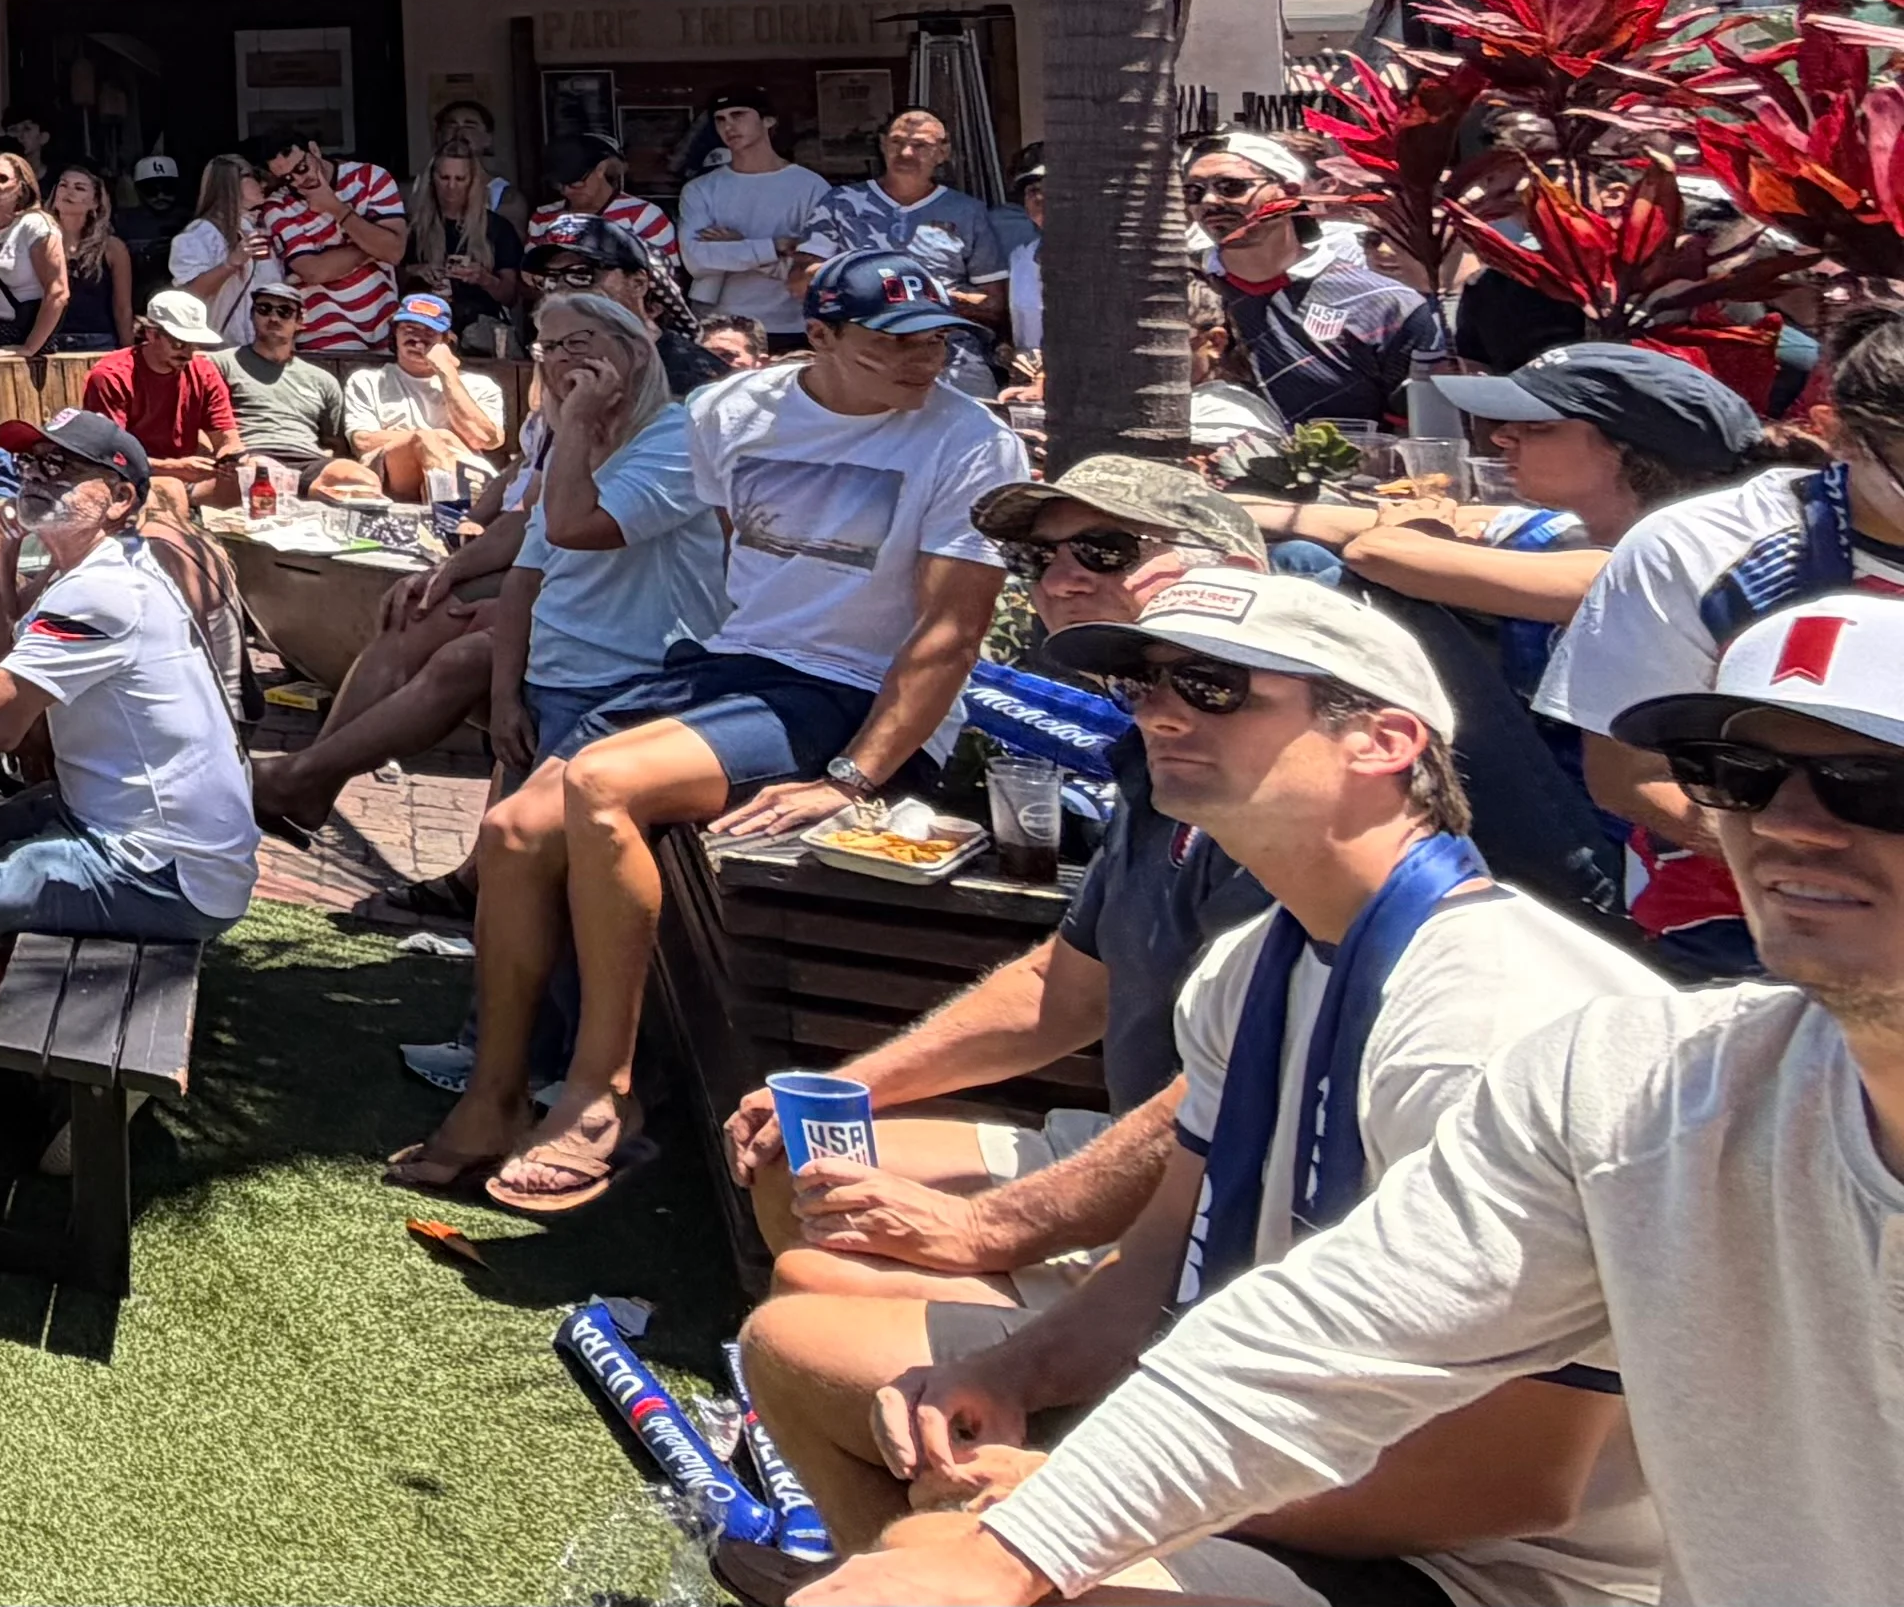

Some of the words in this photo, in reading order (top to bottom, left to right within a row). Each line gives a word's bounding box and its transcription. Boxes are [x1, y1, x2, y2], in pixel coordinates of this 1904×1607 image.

[966, 687, 1110, 748] Michelob
[806, 1123, 866, 1155] USA
[570, 1314, 646, 1407] ULTRA
[642, 1413, 737, 1504] Michelob
